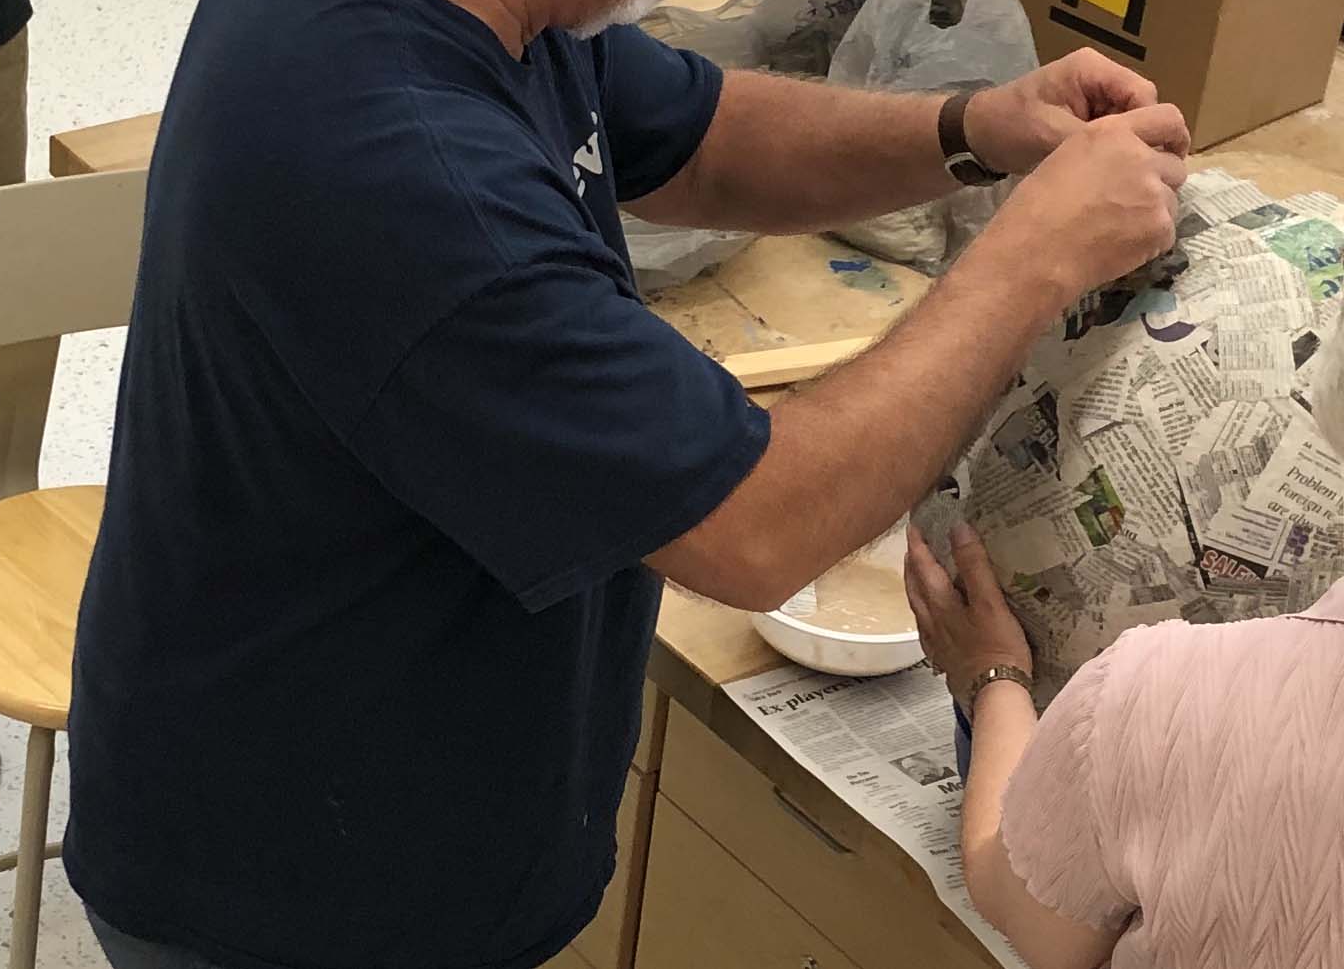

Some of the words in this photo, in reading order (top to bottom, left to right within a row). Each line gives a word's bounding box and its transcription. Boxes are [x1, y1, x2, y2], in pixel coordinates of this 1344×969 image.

[1286, 466, 1338, 501] Problem
[1267, 501, 1290, 516] are
[1278, 482, 1322, 513] Foreign
[1323, 510, 1335, 521] re
